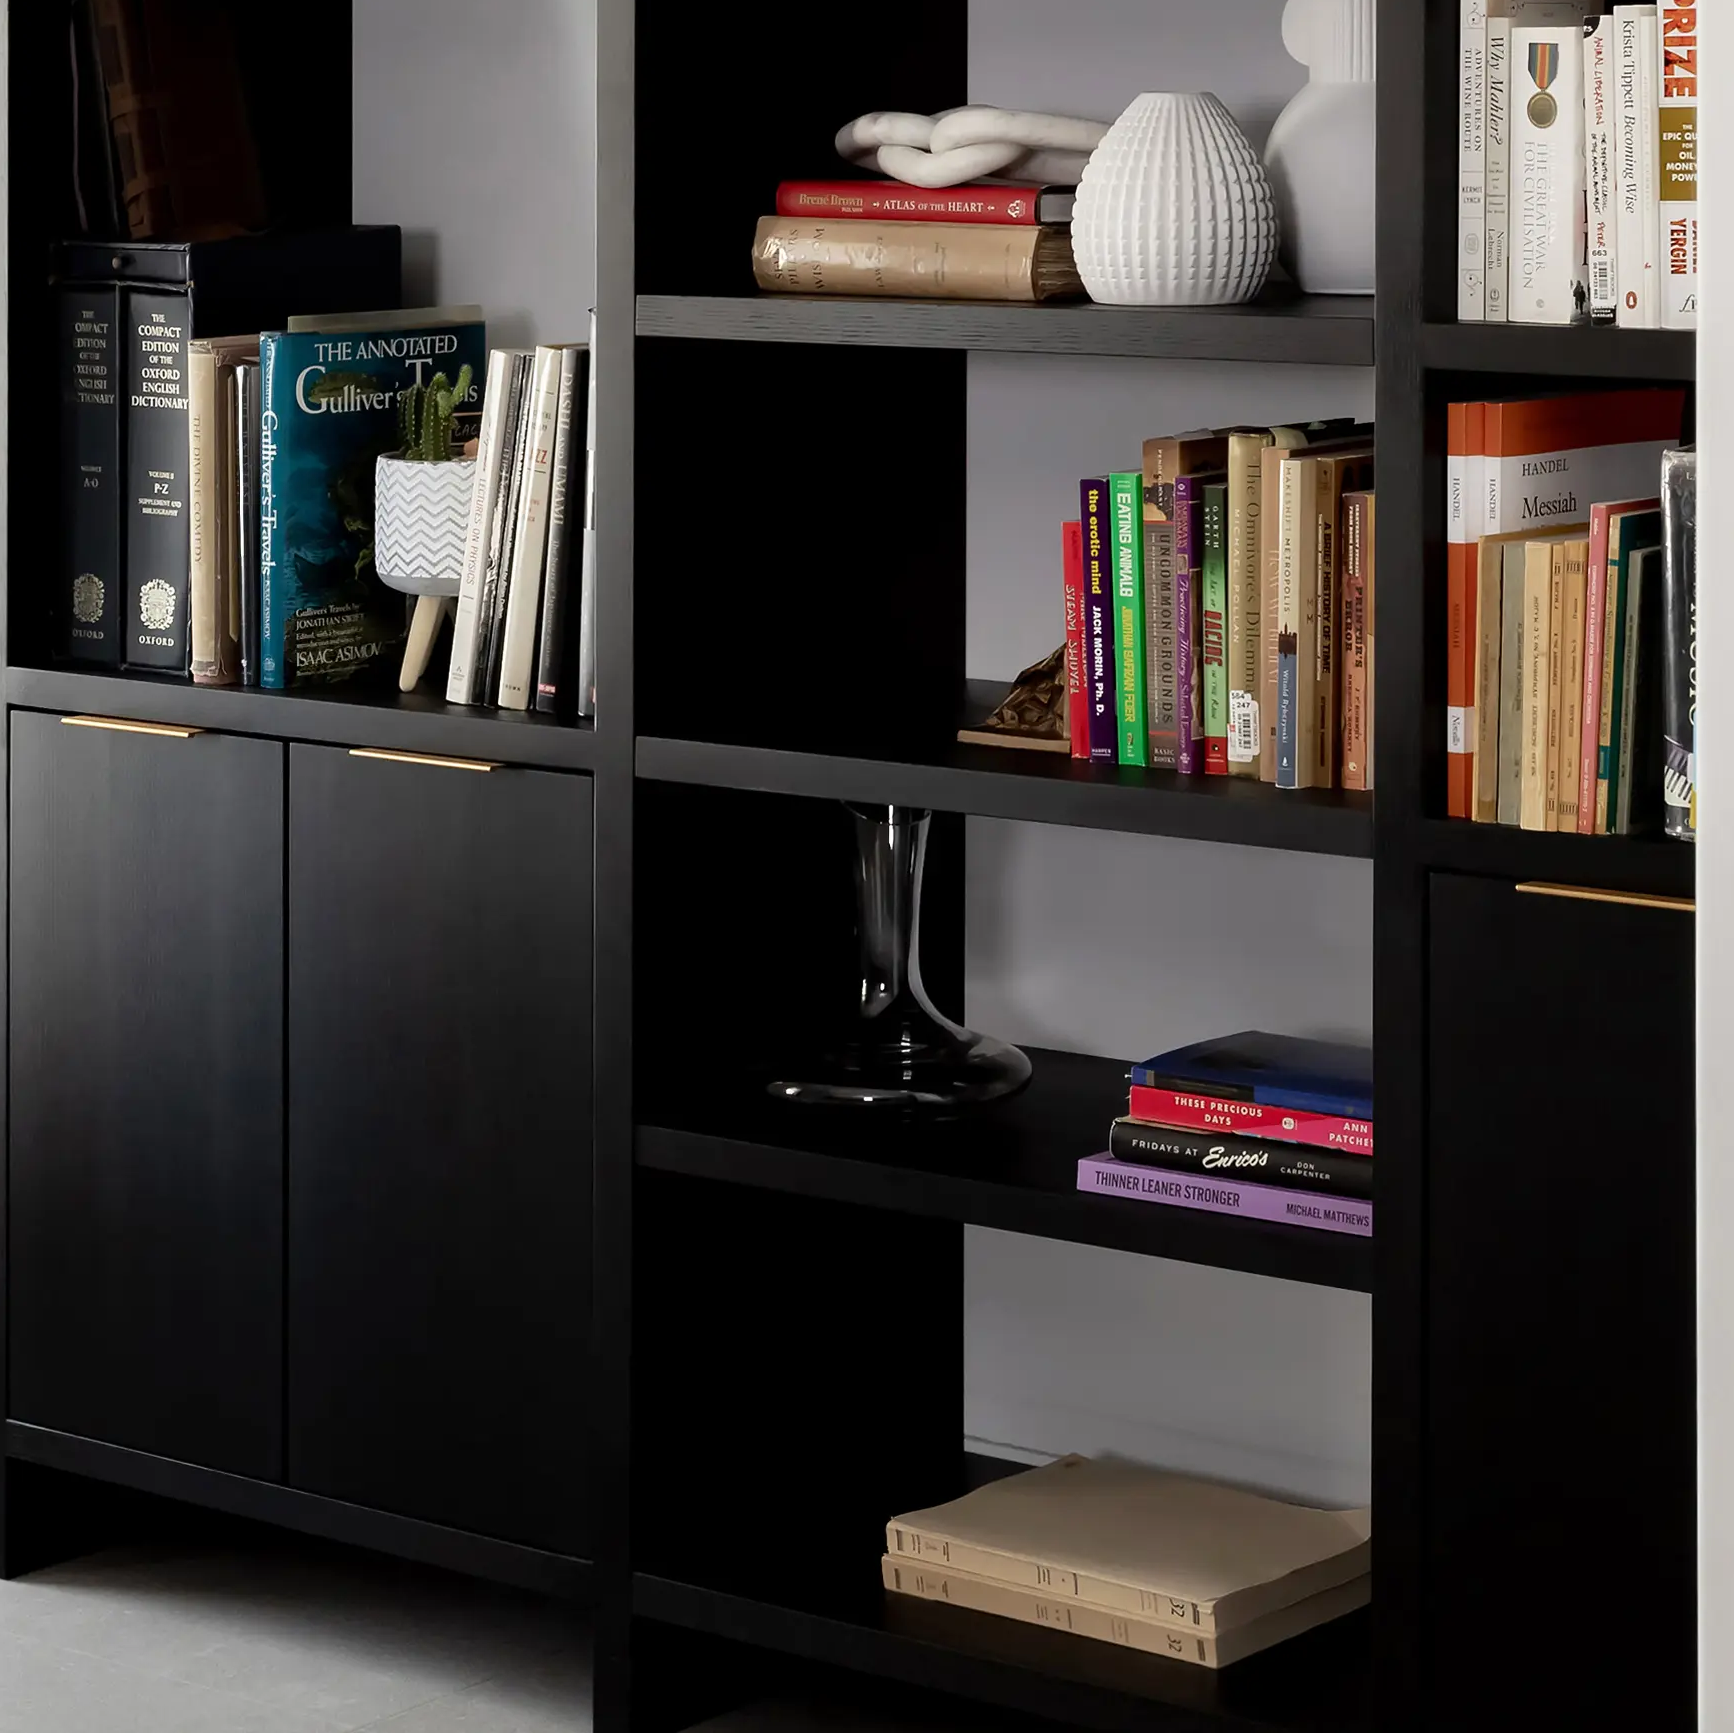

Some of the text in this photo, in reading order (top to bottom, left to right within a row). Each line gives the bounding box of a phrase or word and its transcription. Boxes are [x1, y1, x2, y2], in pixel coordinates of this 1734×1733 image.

[1463, 48, 1472, 152] THE WINE ROUTE
[1474, 48, 1483, 152] ADVENTURES ON
[1487, 36, 1505, 145] Why Mahler?
[1621, 19, 1637, 214] Krista Tippett Becoming Wise
[883, 200, 983, 213] ATLAS OF THE HEART
[1535, 142, 1547, 272] THE GREAT WAR
[1496, 231, 1505, 268] Norman
[1669, 218, 1687, 276] YERGIN
[151, 313, 166, 323] THE
[138, 325, 181, 338] COMPACT
[142, 341, 180, 352] EDITION
[314, 335, 458, 362] THE ANNOTATED
[149, 355, 172, 364] OF THE
[142, 367, 180, 380] OXFORD
[142, 382, 180, 395] ENGLISH
[131, 396, 189, 410] DICTIONARY
[193, 448, 201, 496] DIVINE
[1522, 458, 1569, 476] HANDEL
[261, 410, 278, 576] Gulliver's Travels
[1452, 477, 1461, 522] HANDEL
[1489, 477, 1497, 523] HANDEL
[1521, 493, 1577, 518] Messiah
[194, 502, 202, 564] COMEDY
[466, 478, 487, 587] LECTURES ON PHYSICS
[1089, 489, 1102, 595] the erotic mind
[1233, 508, 1241, 644] MICHAEL POLLAN
[139, 635, 174, 647] OXFORD
[296, 642, 382, 668] ISAAC ASIMOV
[1174, 1096, 1263, 1118] THESE PRECIOUS
[1204, 1114, 1231, 1126] DAYS
[1343, 1122, 1368, 1133] ANN
[1132, 1139, 1198, 1157] FRIDAYS AT
[1202, 1146, 1269, 1169] Enrico's
[1280, 1166, 1331, 1180] CARPENTER
[1297, 1162, 1315, 1170] DON
[1095, 1170, 1240, 1208] THINNER LEANER STRONGER
[1286, 1203, 1370, 1227] MICHAEL MATTHEWS
